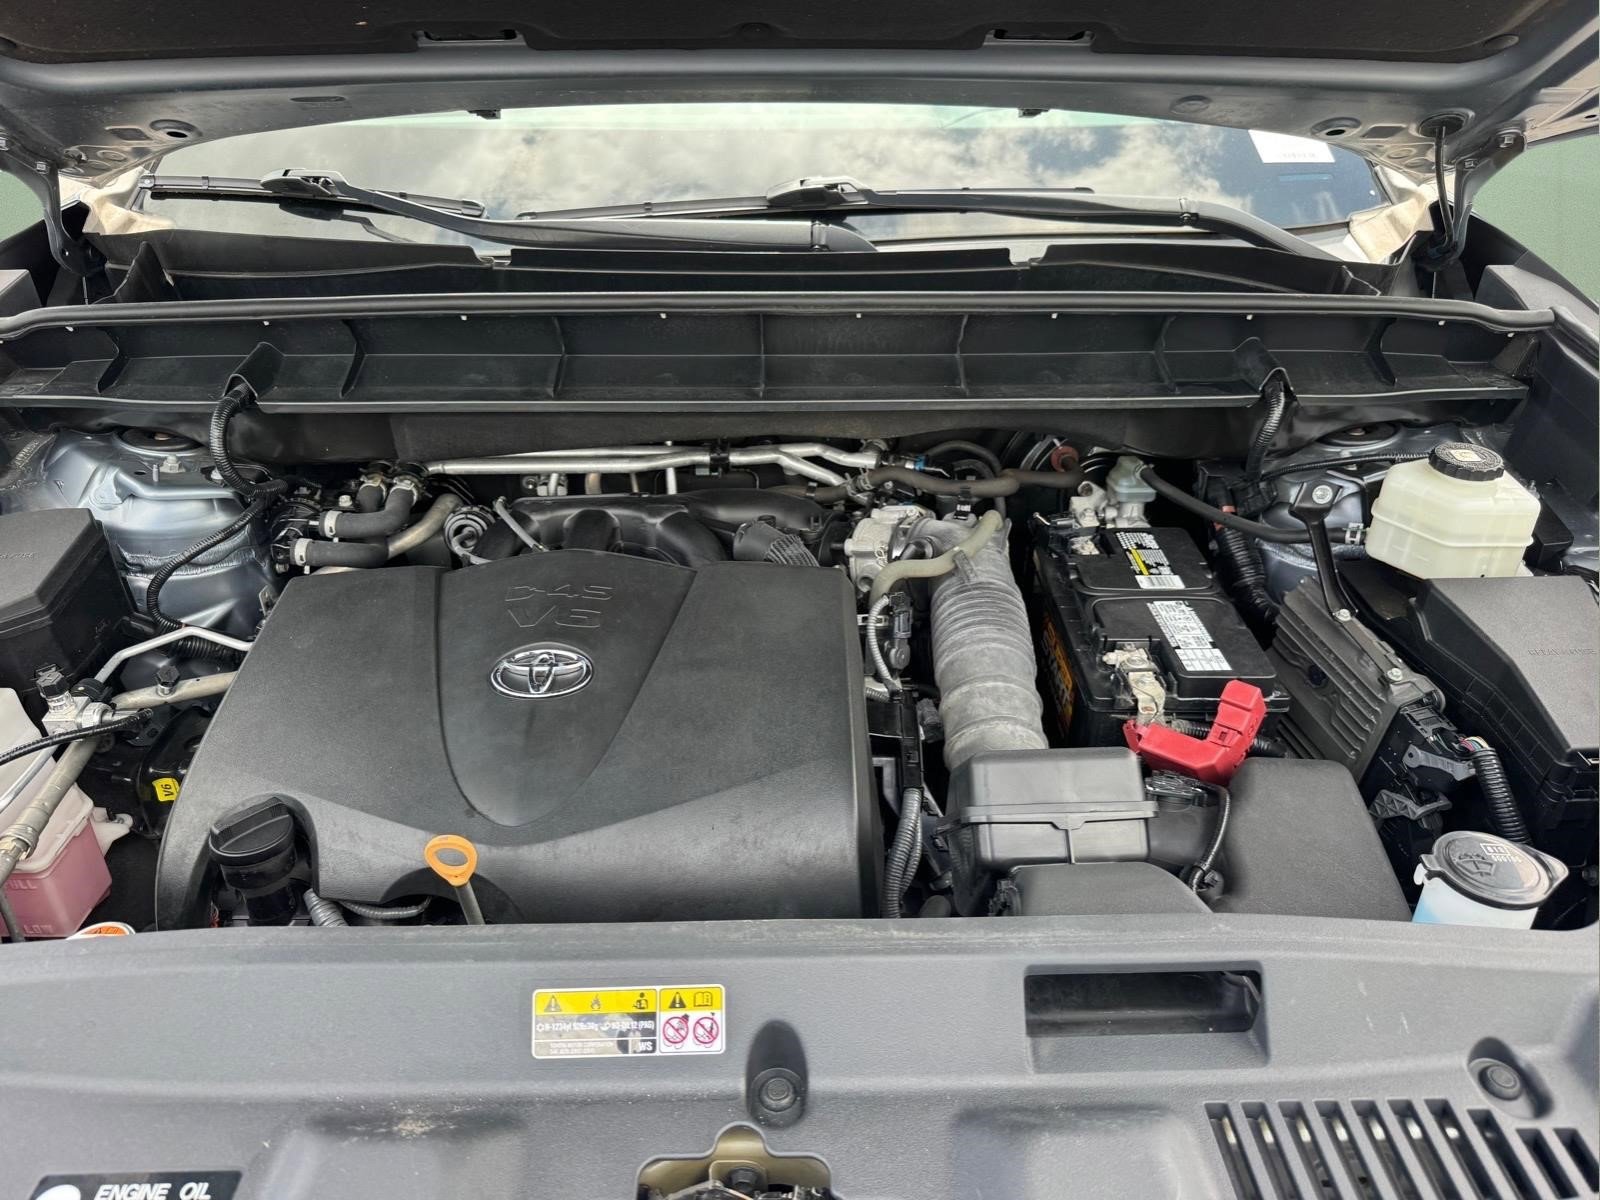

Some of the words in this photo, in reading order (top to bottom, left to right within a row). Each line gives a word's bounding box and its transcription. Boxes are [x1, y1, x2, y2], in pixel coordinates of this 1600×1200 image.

[507, 604, 602, 629] V6
[160, 783, 175, 797] V6
[638, 1041, 653, 1053] WS
[93, 1183, 171, 1200] ENGINE
[178, 1182, 212, 1200] OIL
